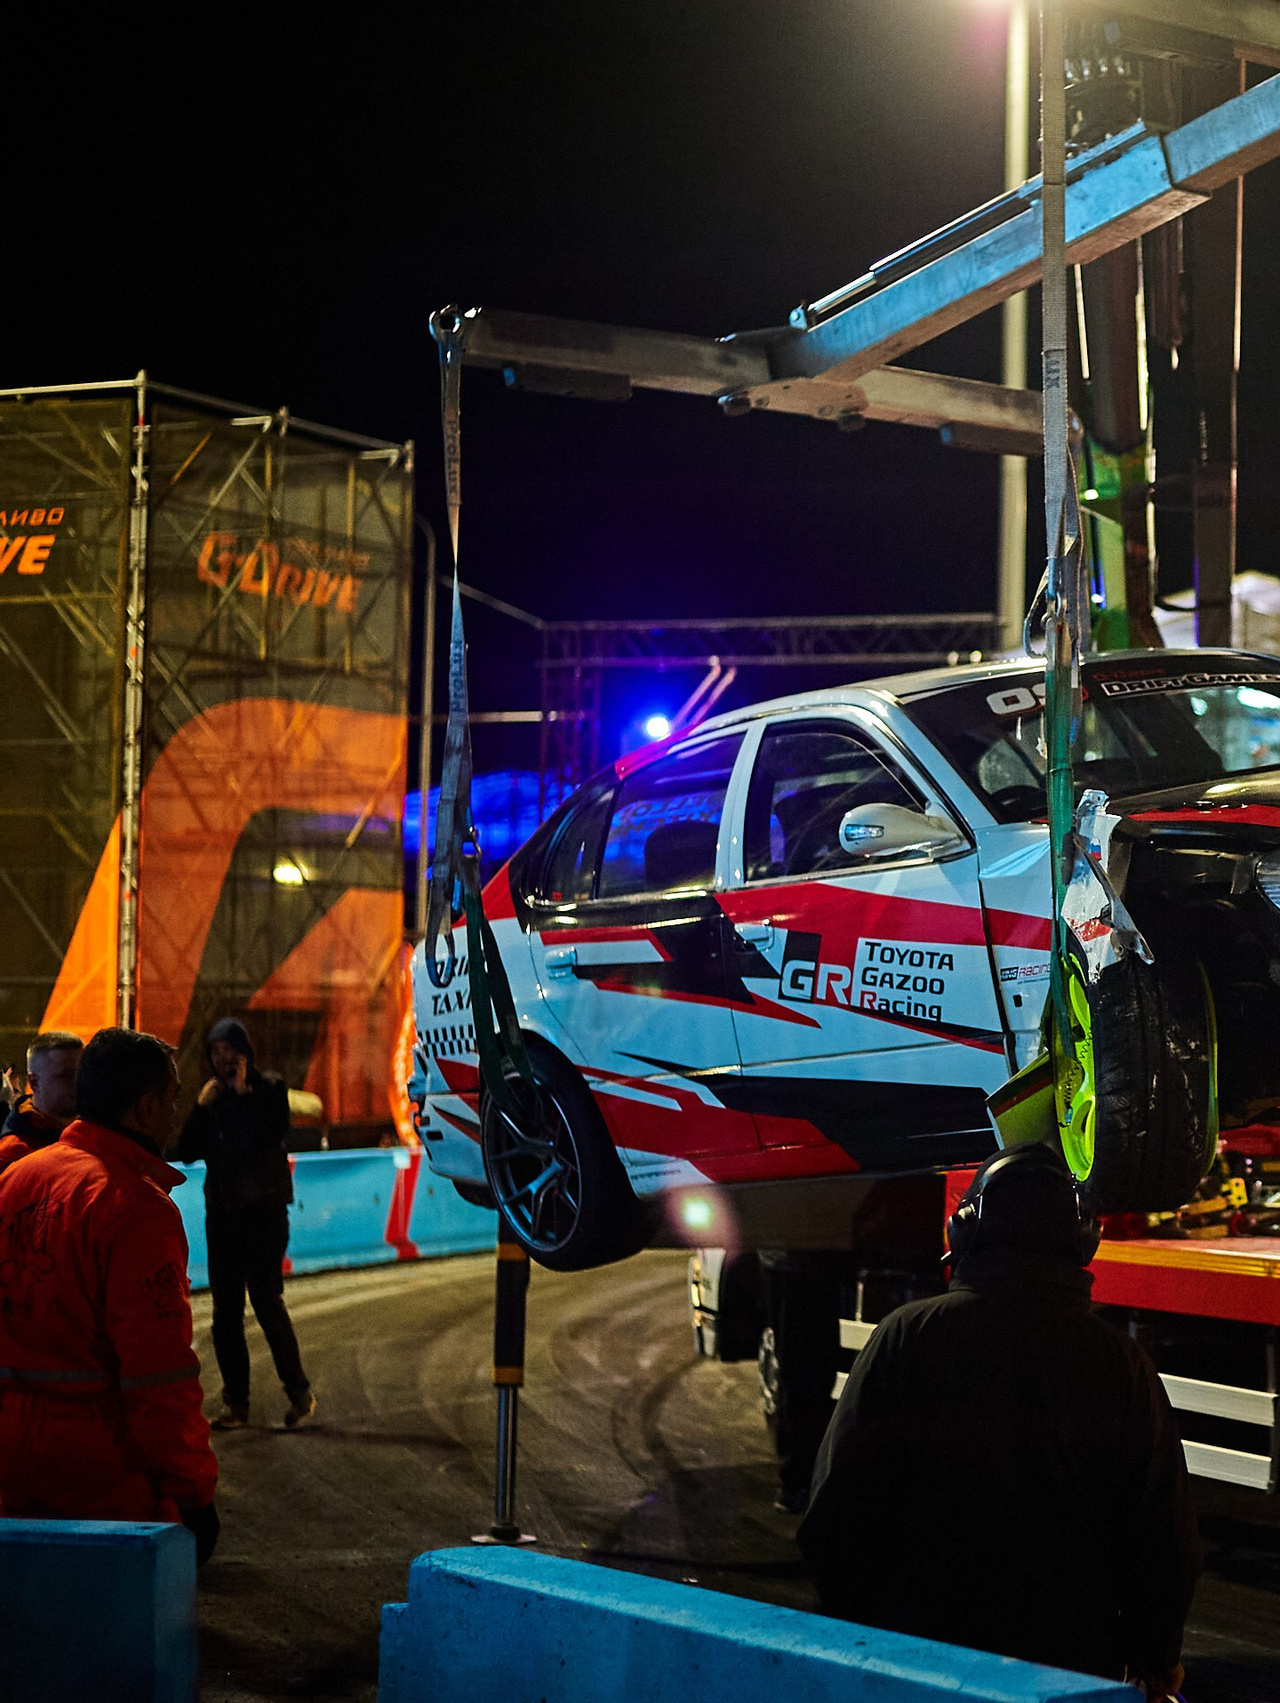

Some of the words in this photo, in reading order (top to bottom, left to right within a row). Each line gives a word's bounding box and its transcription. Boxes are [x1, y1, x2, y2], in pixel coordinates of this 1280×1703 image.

[865, 941, 954, 971] TOYOTA
[781, 959, 852, 1006] GR
[861, 966, 945, 995] GAZOO
[860, 990, 942, 1023] Racing
